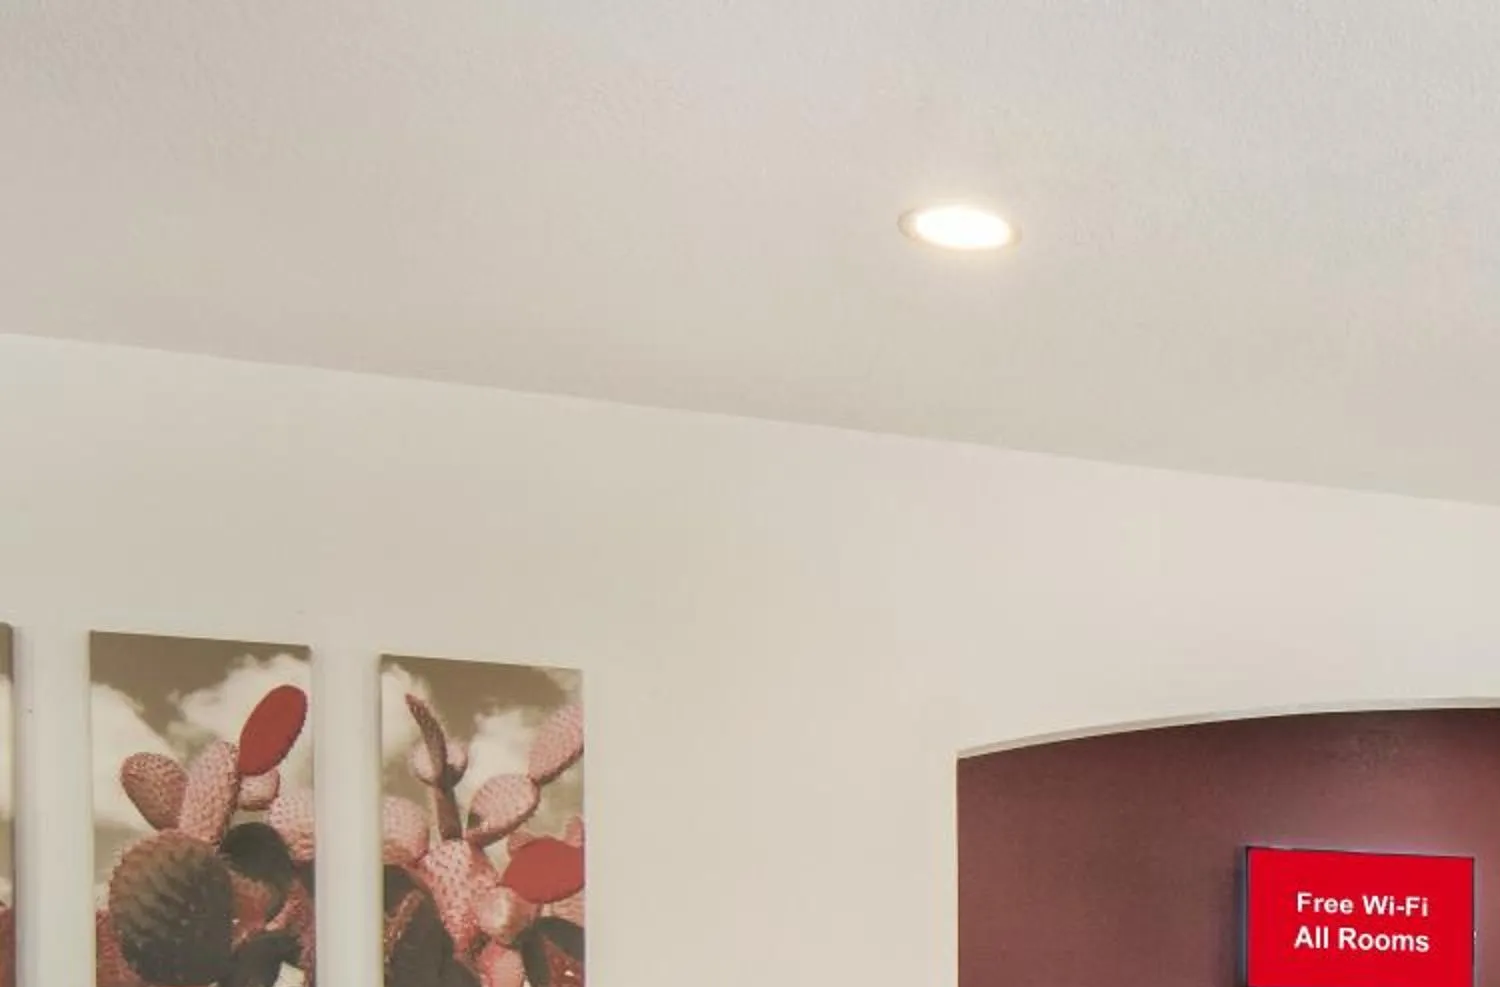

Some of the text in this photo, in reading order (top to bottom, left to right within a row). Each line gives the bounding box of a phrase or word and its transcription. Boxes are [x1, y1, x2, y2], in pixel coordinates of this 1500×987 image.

[1297, 892, 1428, 916] Free Wi-Fi
[1294, 926, 1429, 952] All Rooms
